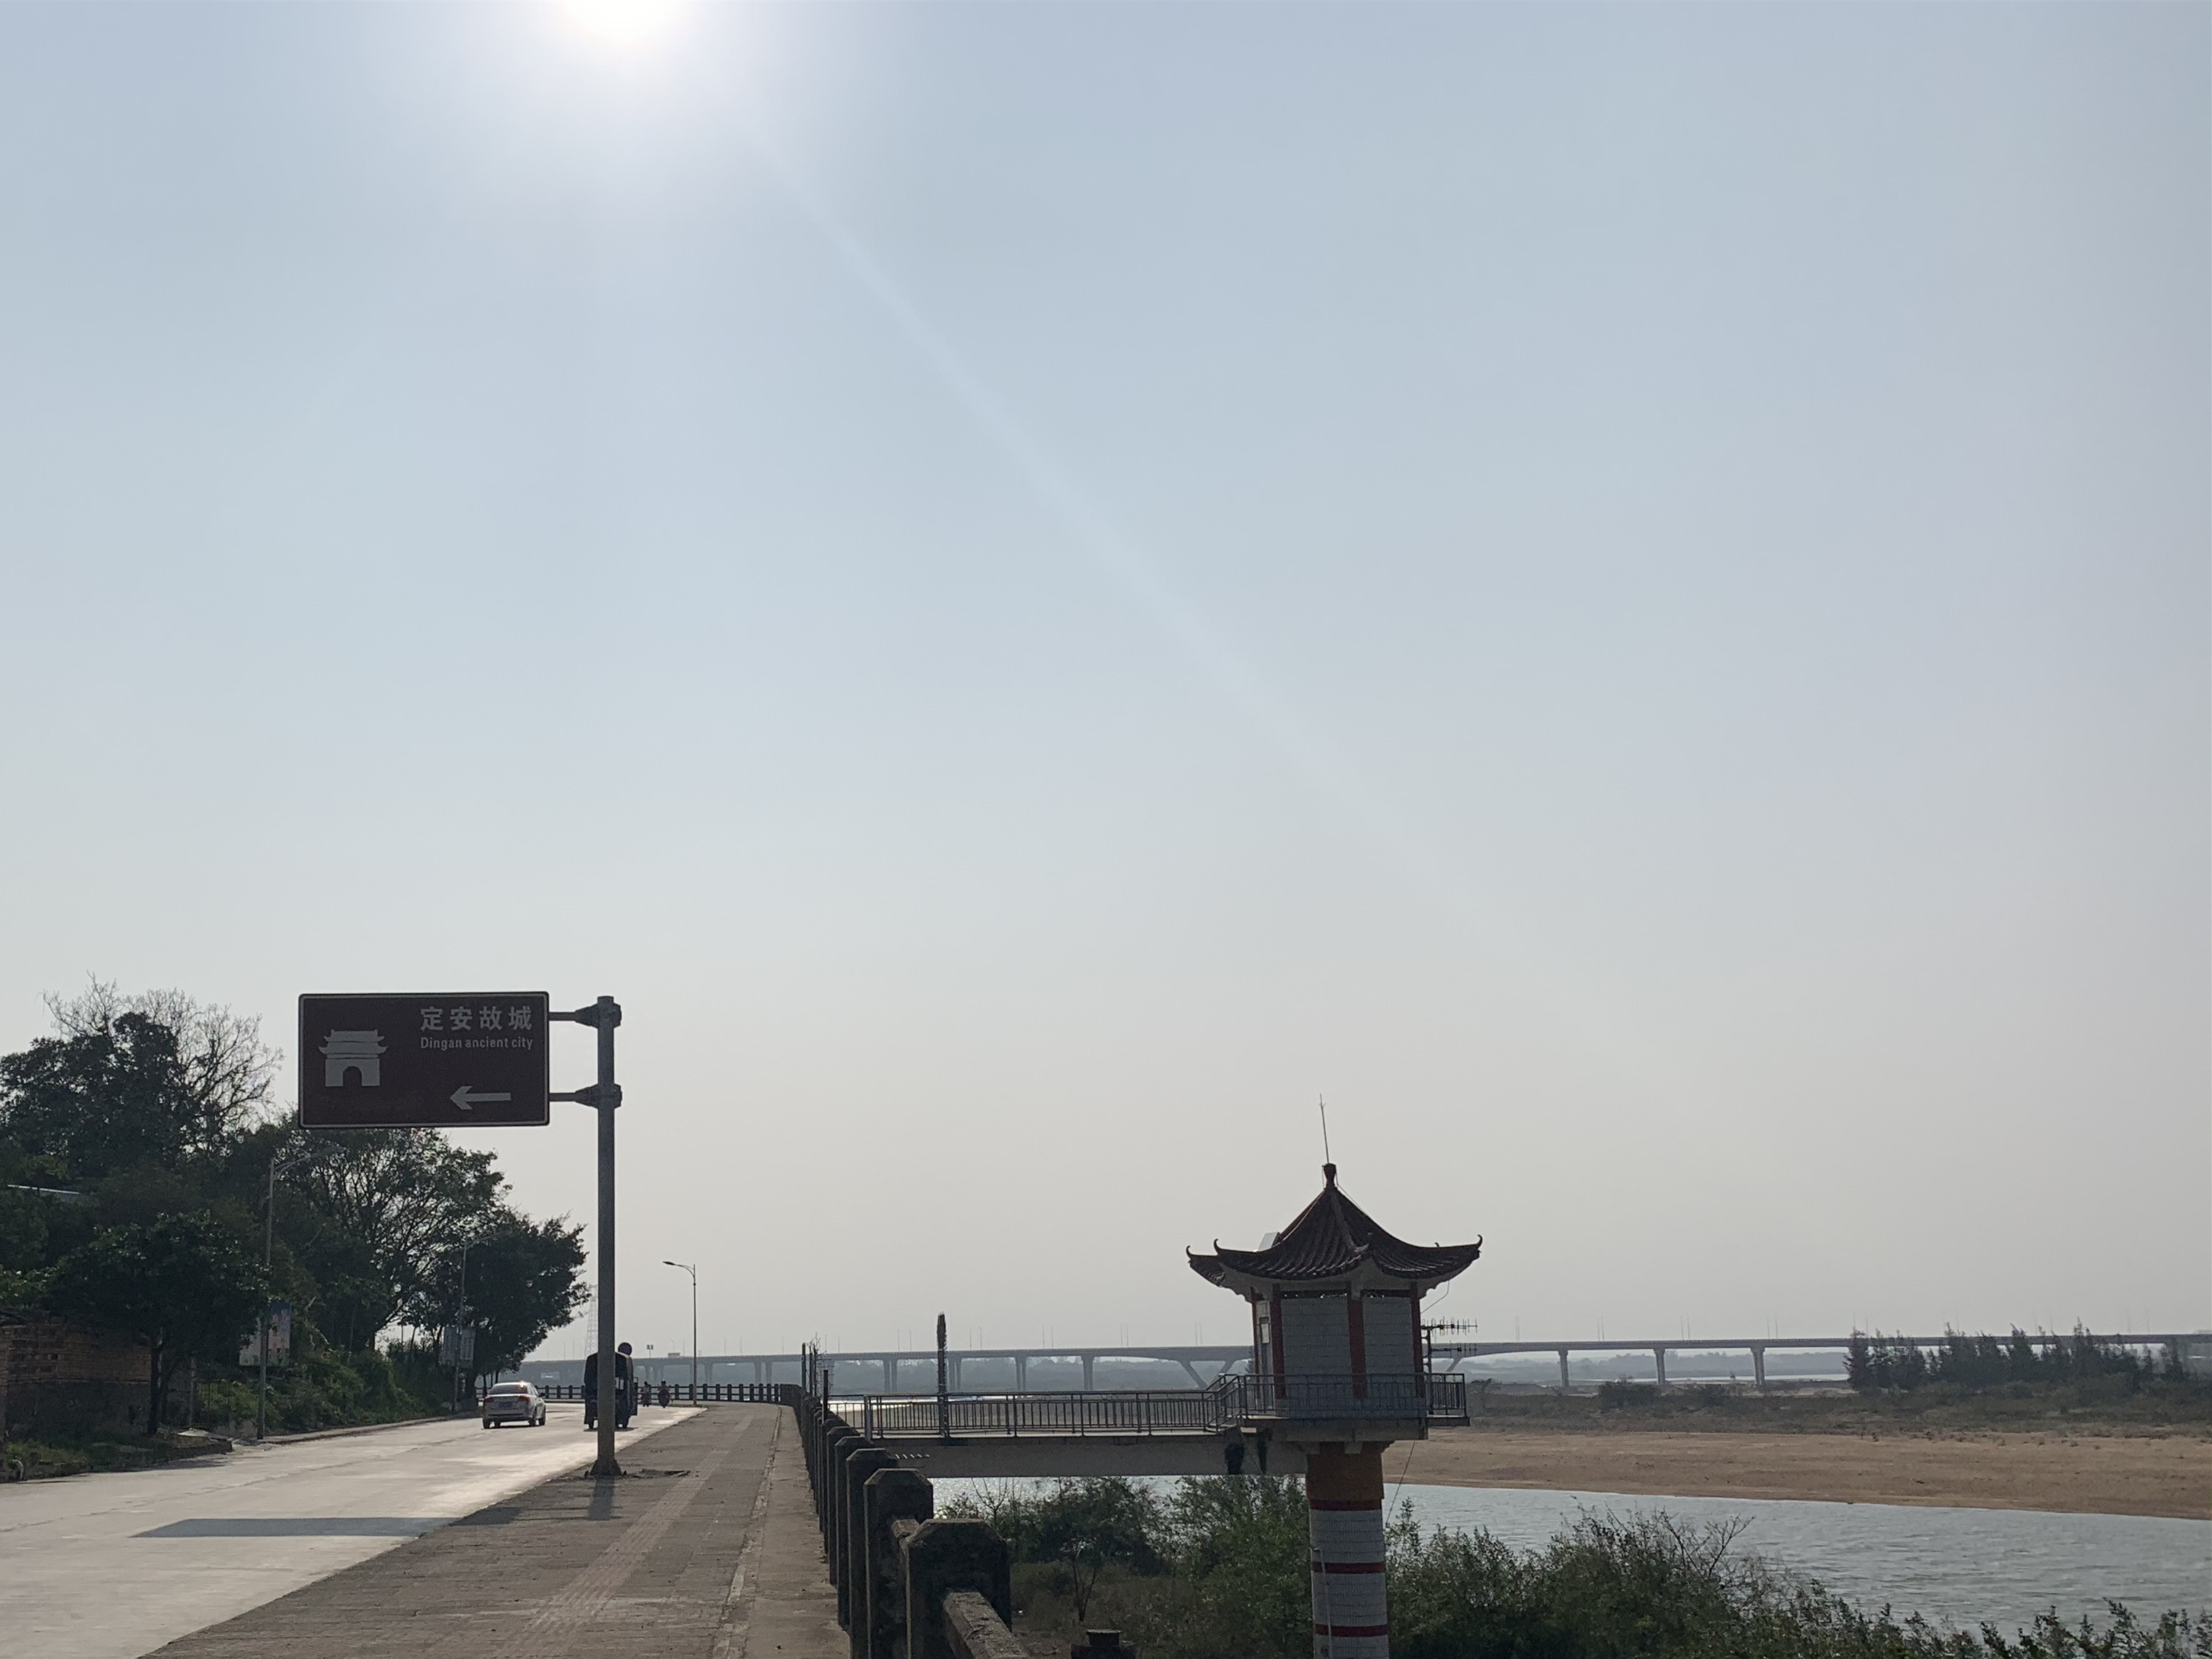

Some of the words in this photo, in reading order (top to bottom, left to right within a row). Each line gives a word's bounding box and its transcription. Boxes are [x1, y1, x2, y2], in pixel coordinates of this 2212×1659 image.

[420, 1005, 532, 1031] 定安故城
[420, 1037, 462, 1051] Dingan
[464, 1036, 509, 1048] ancient
[511, 1036, 533, 1051] city
